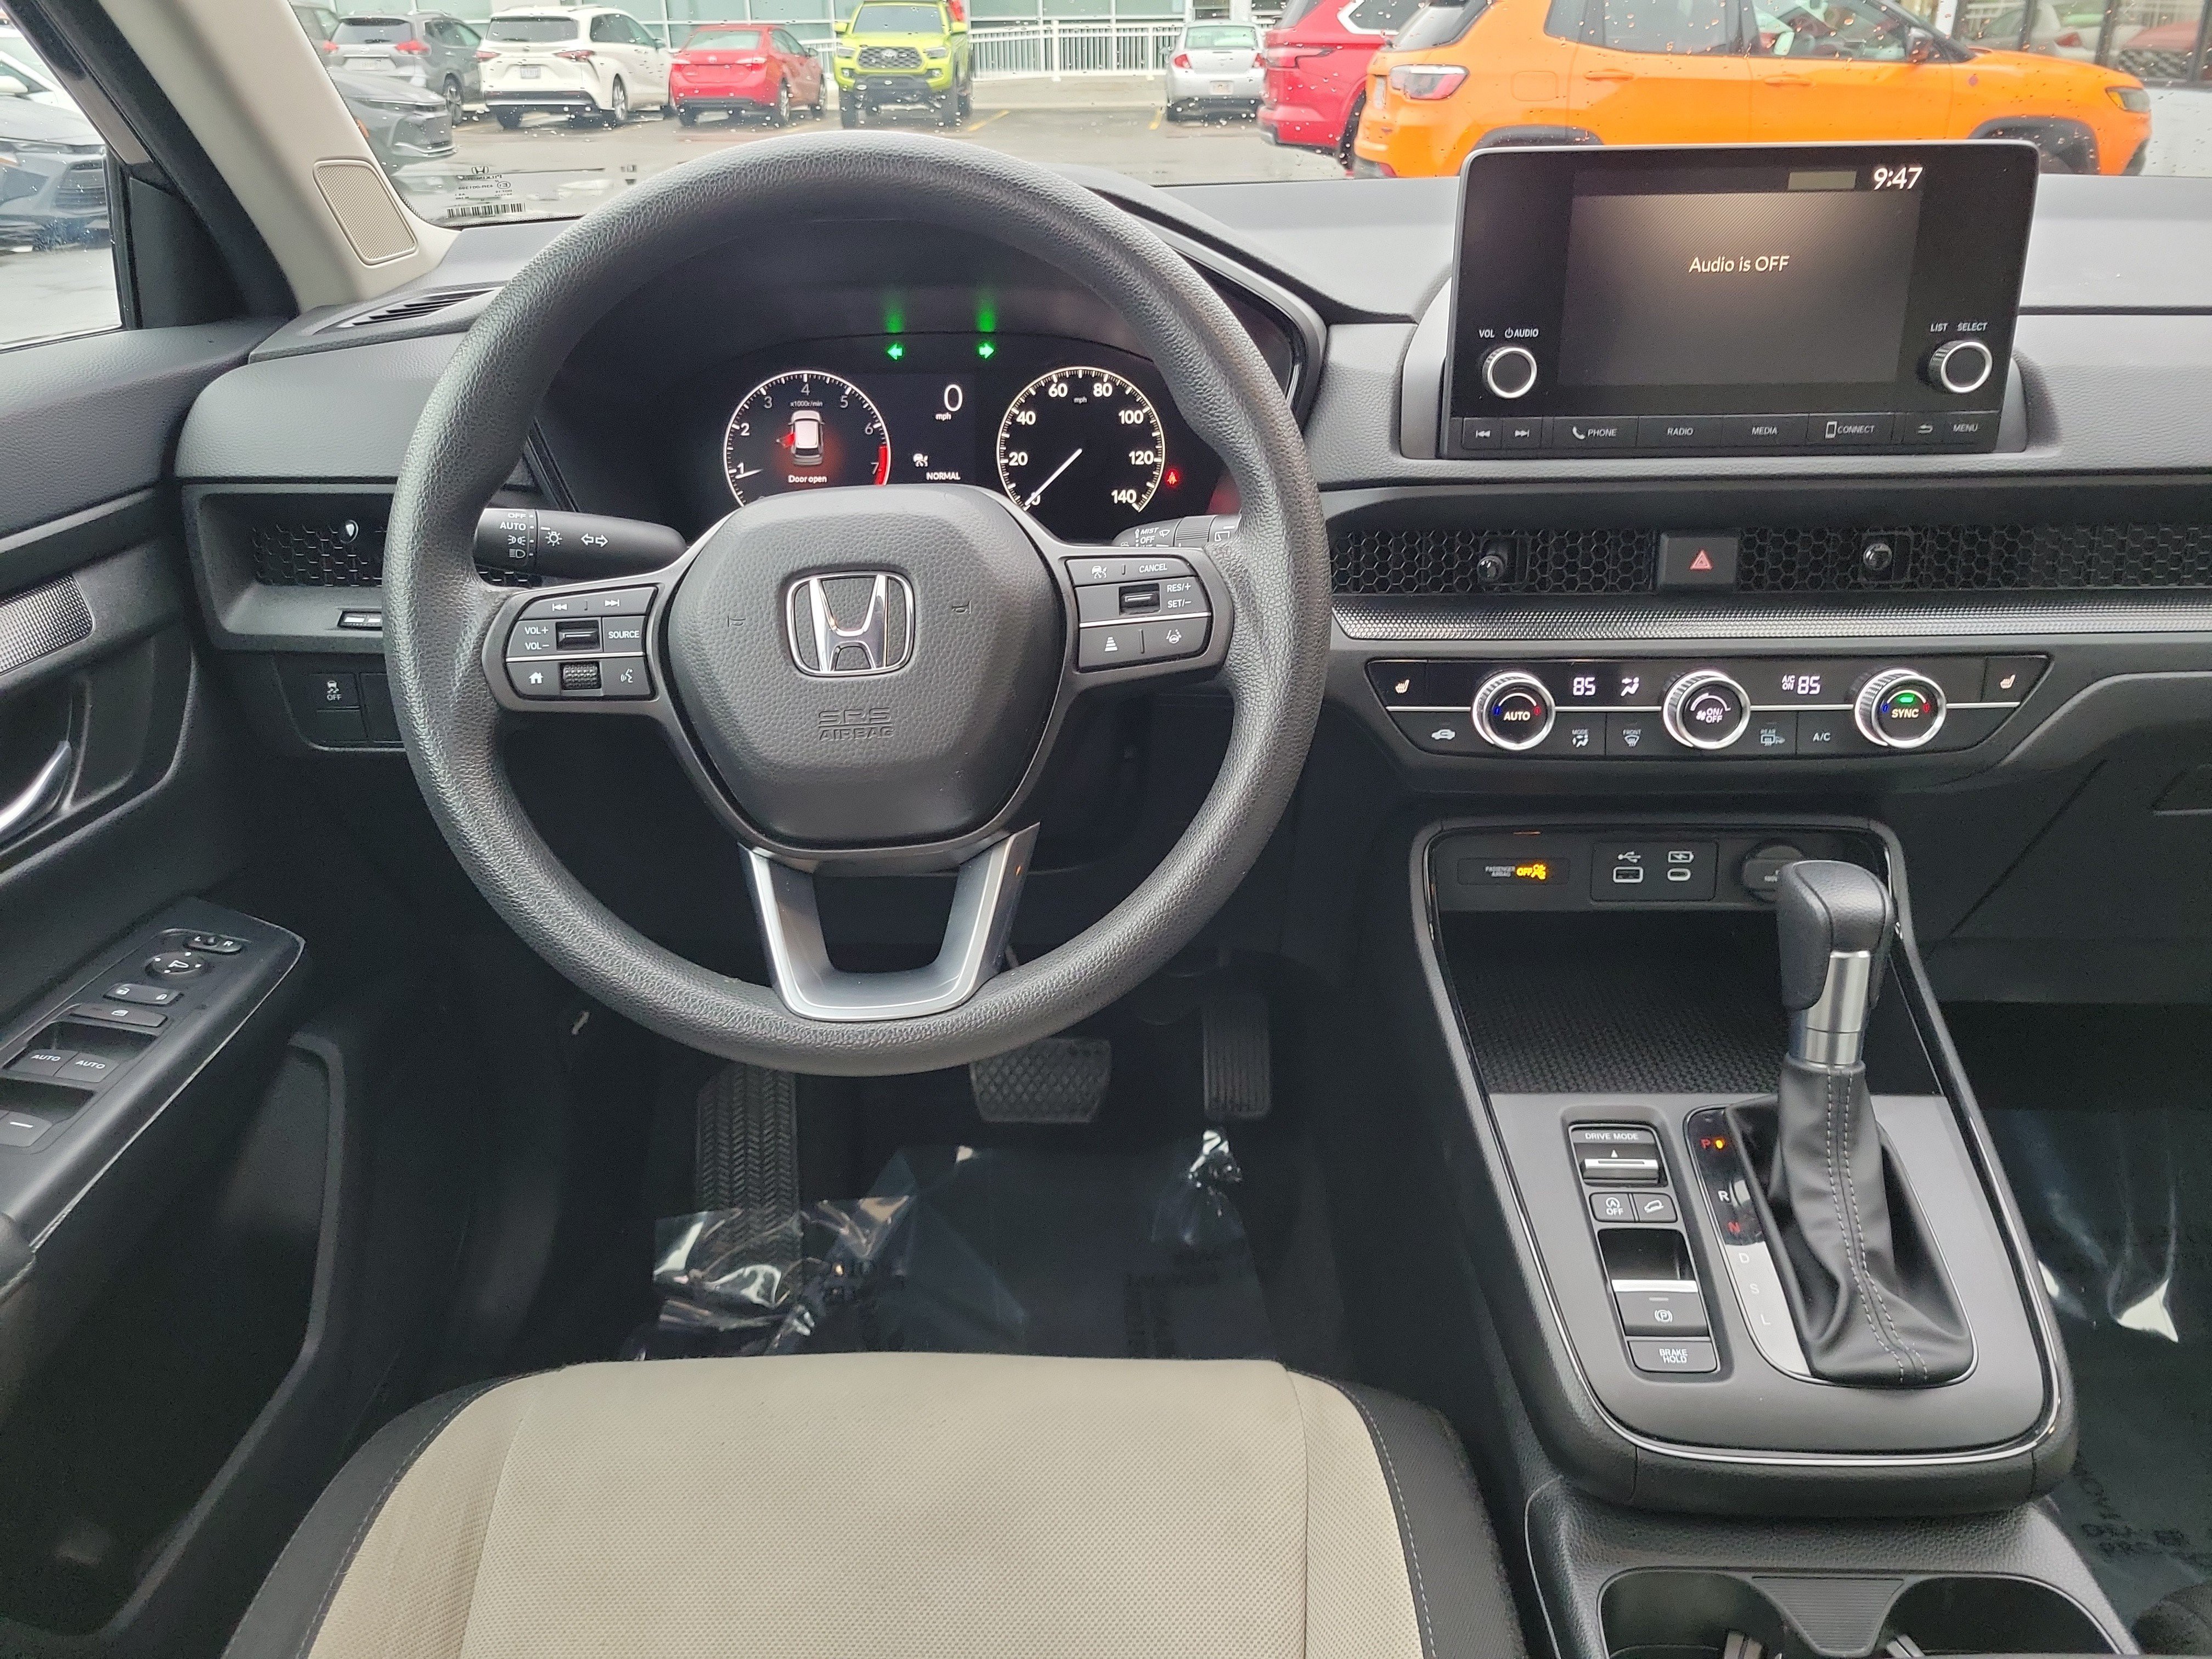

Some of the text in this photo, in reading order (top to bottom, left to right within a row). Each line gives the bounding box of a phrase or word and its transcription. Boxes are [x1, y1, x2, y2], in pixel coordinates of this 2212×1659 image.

[1874, 167, 1923, 190] 9:47
[1689, 255, 1790, 273] Audio is OFF
[1930, 323, 1949, 332] LIST
[1957, 322, 1988, 332] SELECT
[1479, 329, 1496, 338] VOL
[1514, 328, 1539, 338] AUDIO
[801, 383, 811, 396] 4
[1048, 382, 1069, 398] 60
[1092, 382, 1113, 398] 80
[764, 396, 772, 409] 3
[839, 395, 849, 408] 5
[944, 383, 963, 412] 0
[935, 413, 952, 421] mph
[1016, 410, 1036, 425] 40
[1118, 409, 1144, 425] 100
[740, 422, 750, 437] 2
[864, 422, 874, 436] 6
[1587, 428, 1617, 437] PHONE
[1667, 427, 1695, 436] RADIO
[1751, 426, 1779, 437] MEDIA
[1837, 424, 1875, 435] CONNECT
[1953, 424, 1979, 433] MENU
[1008, 451, 1029, 466] 20
[1128, 450, 1154, 465] 120
[737, 462, 745, 474] 1
[870, 461, 880, 475] 7
[788, 475, 827, 484] Door open
[926, 471, 961, 481] NORMAL
[1110, 489, 1137, 504] 140
[499, 521, 527, 531] AUTO
[1140, 527, 1160, 535] MIST
[1140, 535, 1155, 544] OFF
[1138, 563, 1168, 574] CANCEL
[1166, 583, 1192, 594] RES/+
[524, 625, 549, 635] VOL+
[608, 630, 640, 639] SOURCE
[1781, 674, 1796, 684] A/C
[1572, 676, 1596, 696] 85
[1781, 682, 1795, 691] ON
[1797, 675, 1821, 695] 85
[818, 707, 893, 725] SRS
[1503, 710, 1531, 721] AUTO
[1706, 707, 1724, 715] ON/
[1891, 708, 1920, 719] SYNC
[1705, 715, 1723, 724] OFF
[818, 726, 895, 742] AIRBAG
[1813, 732, 1831, 742] A/C
[1516, 867, 1533, 876] OFF
[75, 1059, 106, 1069] AUTO
[1701, 1138, 1711, 1148] P
[1718, 1189, 1730, 1202] R
[1606, 1207, 1624, 1216] OFF
[1728, 1222, 1741, 1234] N
[1738, 1252, 1750, 1263] D
[1749, 1283, 1760, 1295] S
[1760, 1313, 1771, 1325] L
[1659, 1348, 1688, 1357] BRAKE
[1663, 1355, 1688, 1364] HOLD
